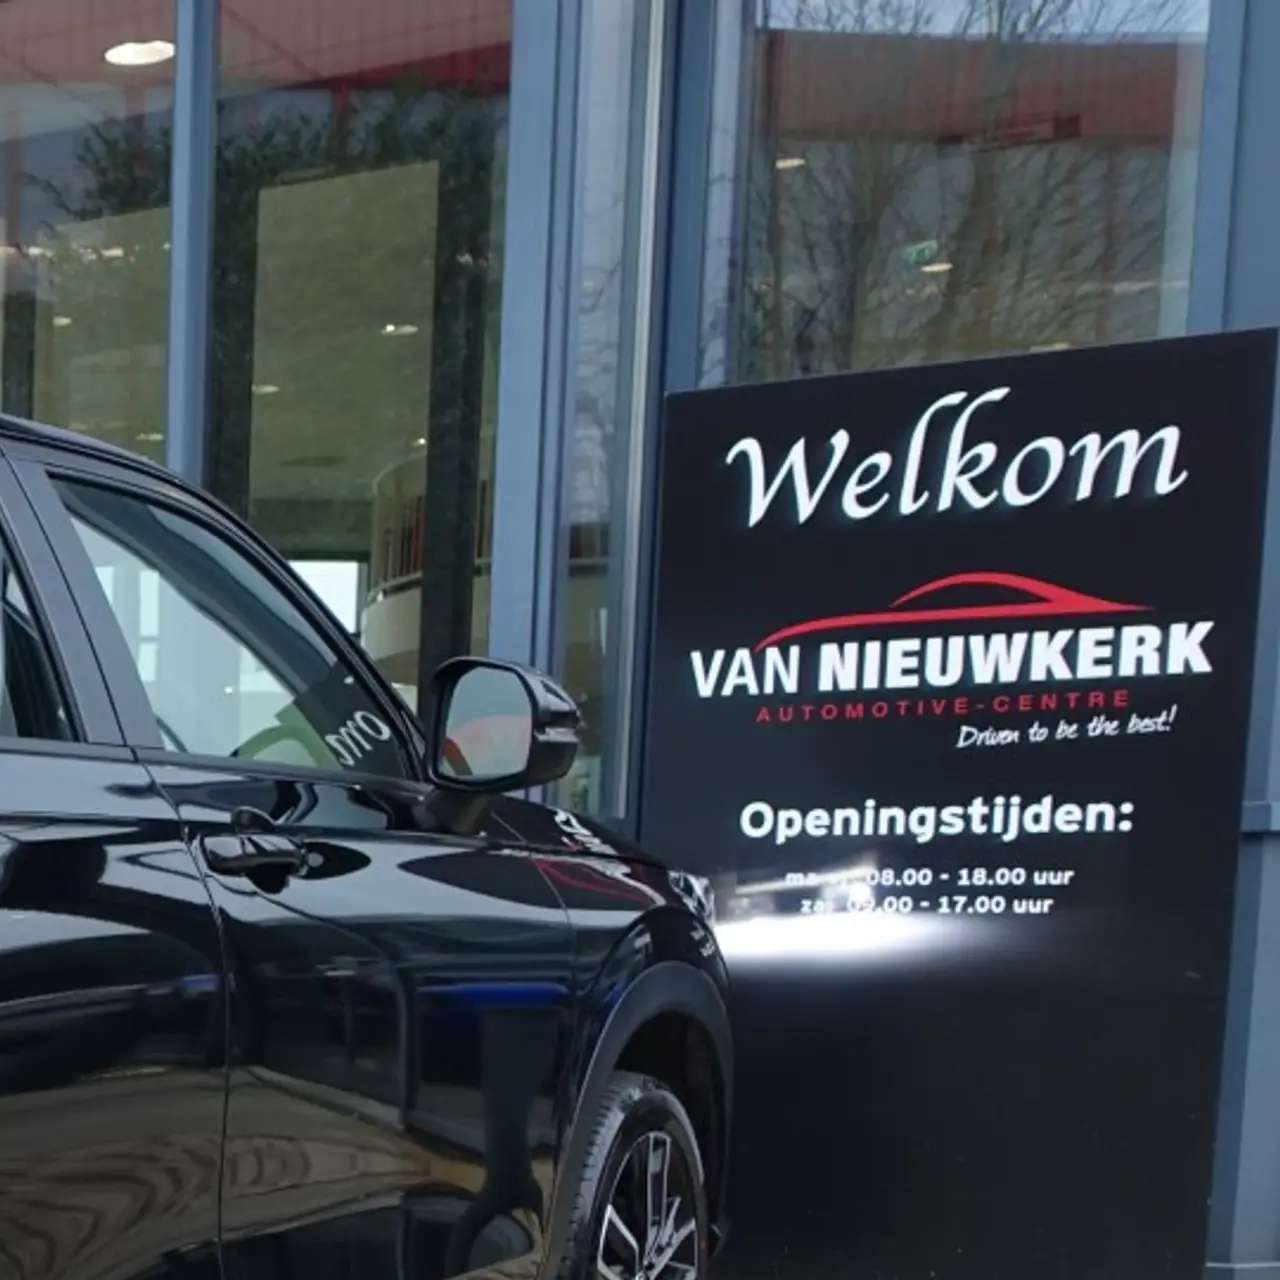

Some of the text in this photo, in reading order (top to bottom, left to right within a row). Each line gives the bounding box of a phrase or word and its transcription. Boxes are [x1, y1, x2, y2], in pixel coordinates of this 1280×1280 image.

[726, 387, 1188, 527] Welkom
[691, 621, 1215, 698] VAN NIEUWKERK
[756, 690, 1131, 723] AUTOMOTIVE-CENTRE
[955, 704, 1178, 748] Driven to be the best!
[739, 795, 1134, 845] Openingstijden:
[866, 867, 933, 886] 08.00
[957, 867, 1026, 886] 18.00
[1033, 869, 1075, 886] uur
[938, 896, 1005, 914] 17.00
[1013, 897, 1054, 914] uur
